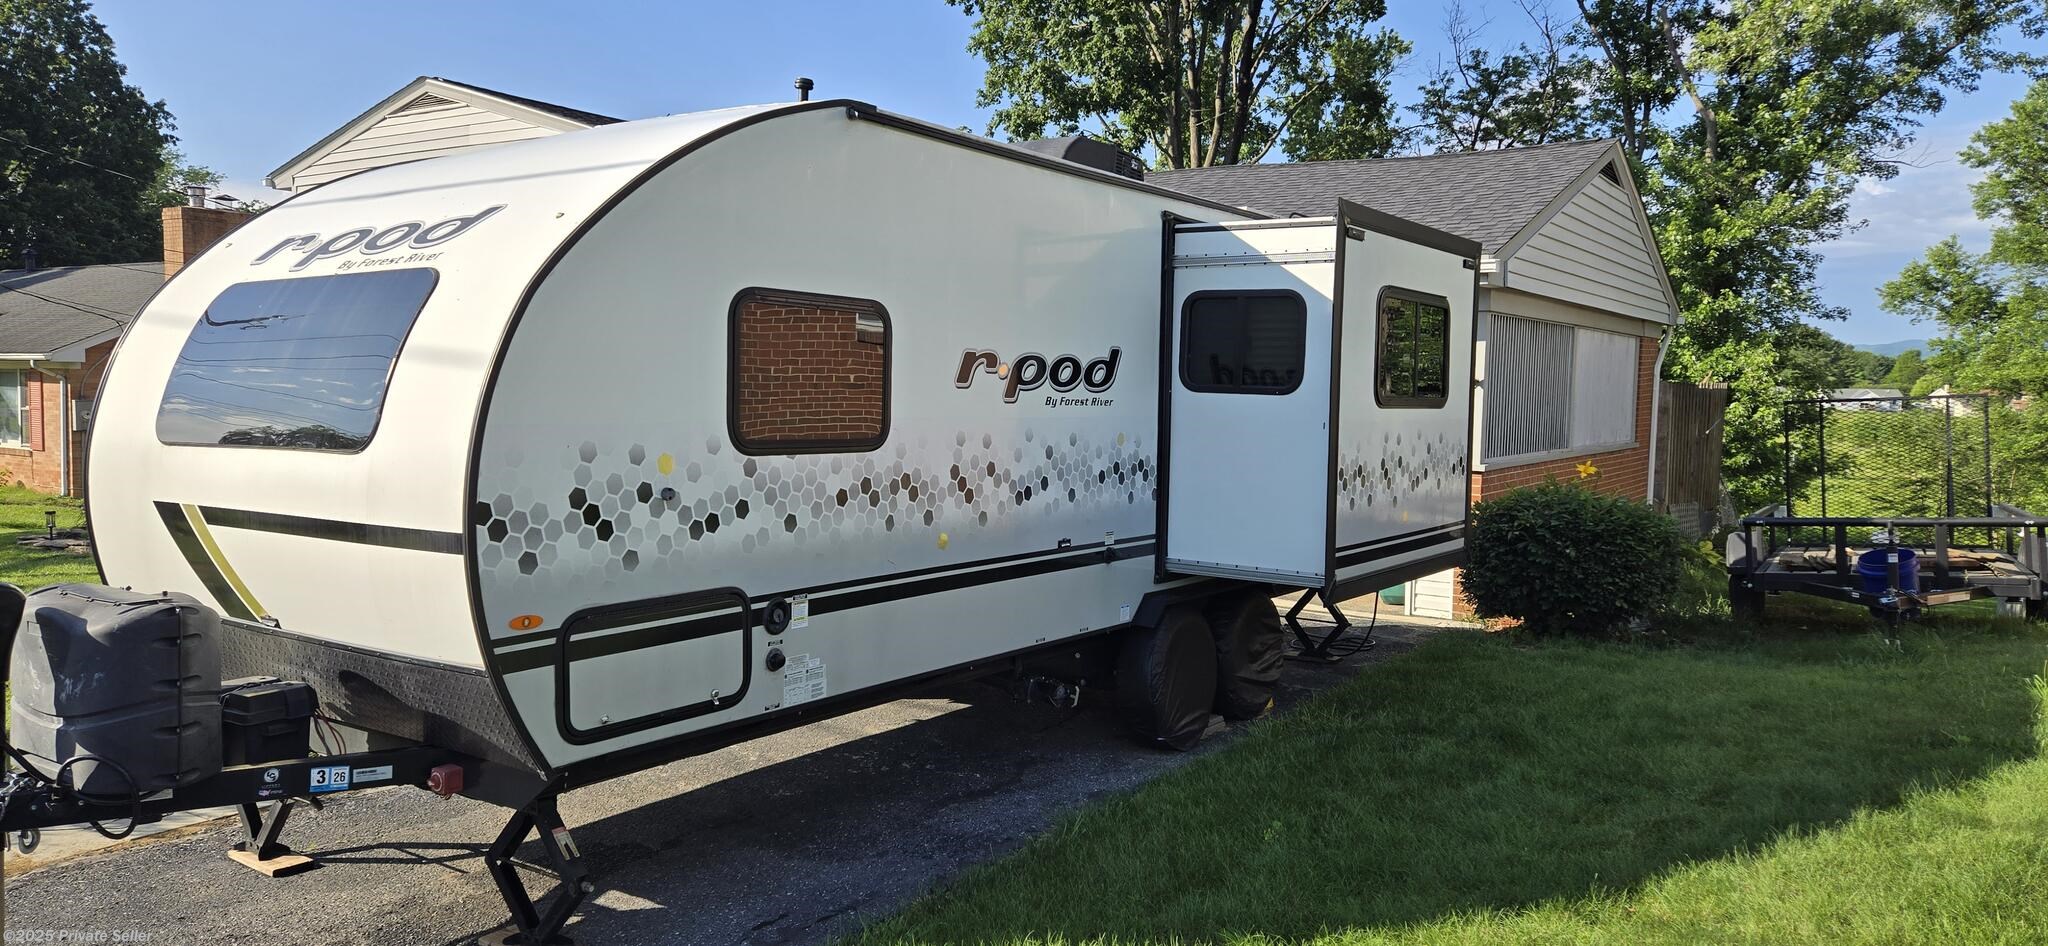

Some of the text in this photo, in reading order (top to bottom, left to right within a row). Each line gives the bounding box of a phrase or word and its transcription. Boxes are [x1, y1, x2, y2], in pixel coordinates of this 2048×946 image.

[357, 256, 404, 268] Forest
[404, 252, 444, 263] River
[1045, 396, 1114, 408] By Forest River
[316, 769, 326, 784] 3
[333, 772, 346, 783] 26
